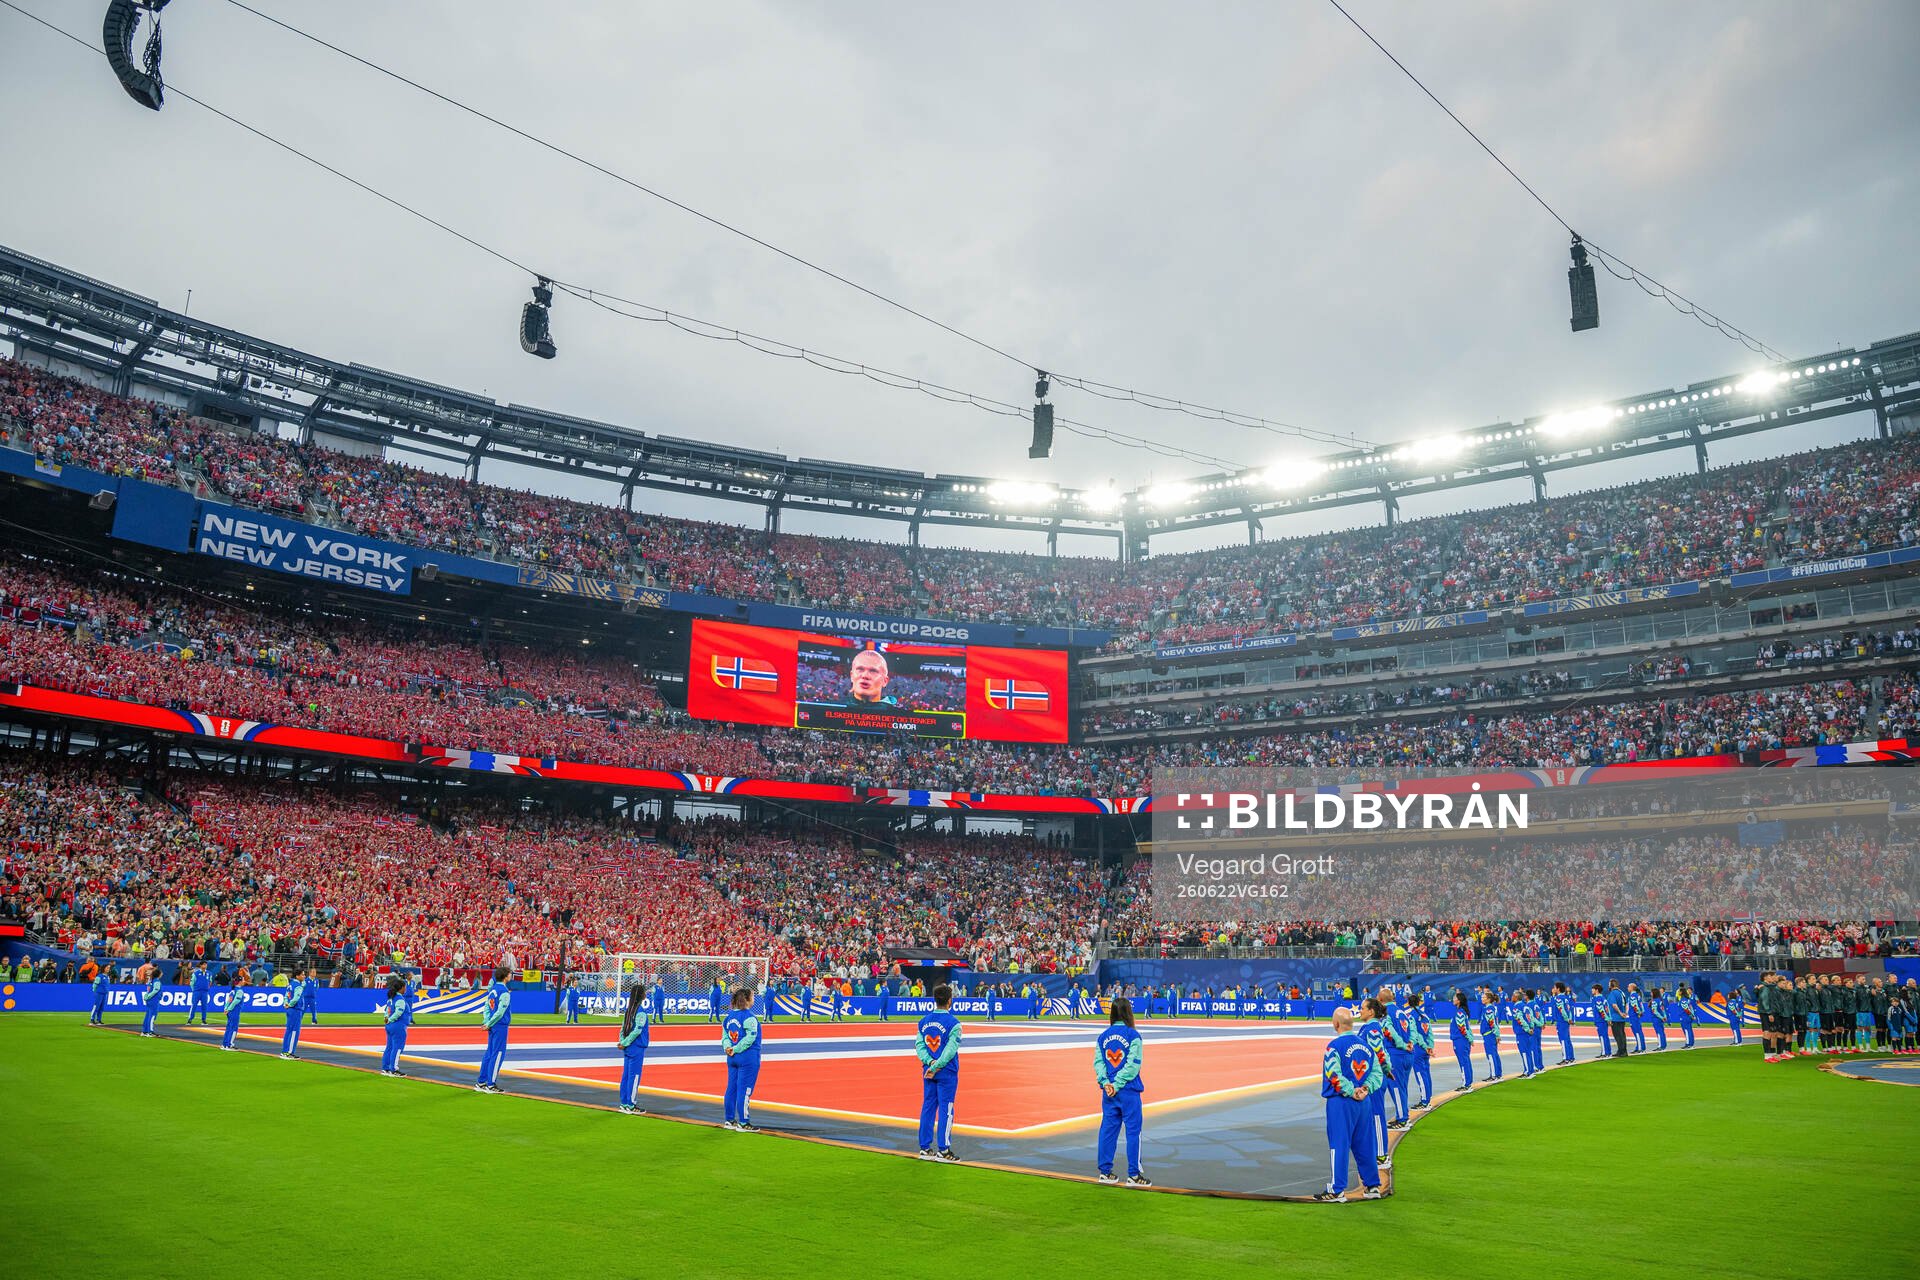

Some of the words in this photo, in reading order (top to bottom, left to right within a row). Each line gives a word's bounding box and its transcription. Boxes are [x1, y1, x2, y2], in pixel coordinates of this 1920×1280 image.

[203, 513, 296, 549] NEW
[304, 535, 408, 573] YORK
[200, 537, 277, 566] NEW
[282, 557, 405, 592] JERSEY
[1791, 557, 1867, 577] #FIFAWorldCup
[802, 614, 834, 628] FIFA
[835, 617, 888, 633] WORLD
[890, 622, 919, 636] CUP
[920, 625, 969, 640] 2026
[1162, 649, 1186, 657] NEW
[1187, 644, 1217, 653] YORK
[1245, 636, 1289, 648] JERSEY
[882, 715, 896, 723] DET
[899, 723, 917, 731] MOR
[107, 991, 138, 1006] IFA
[897, 1001, 917, 1012] FIFA
[953, 1002, 971, 1011] CUP
[971, 1002, 1002, 1012] 206
[1181, 1001, 1203, 1011] FIFA
[1203, 1002, 1236, 1012] ORLD
[1103, 1034, 1130, 1049] VOLUNTEER
